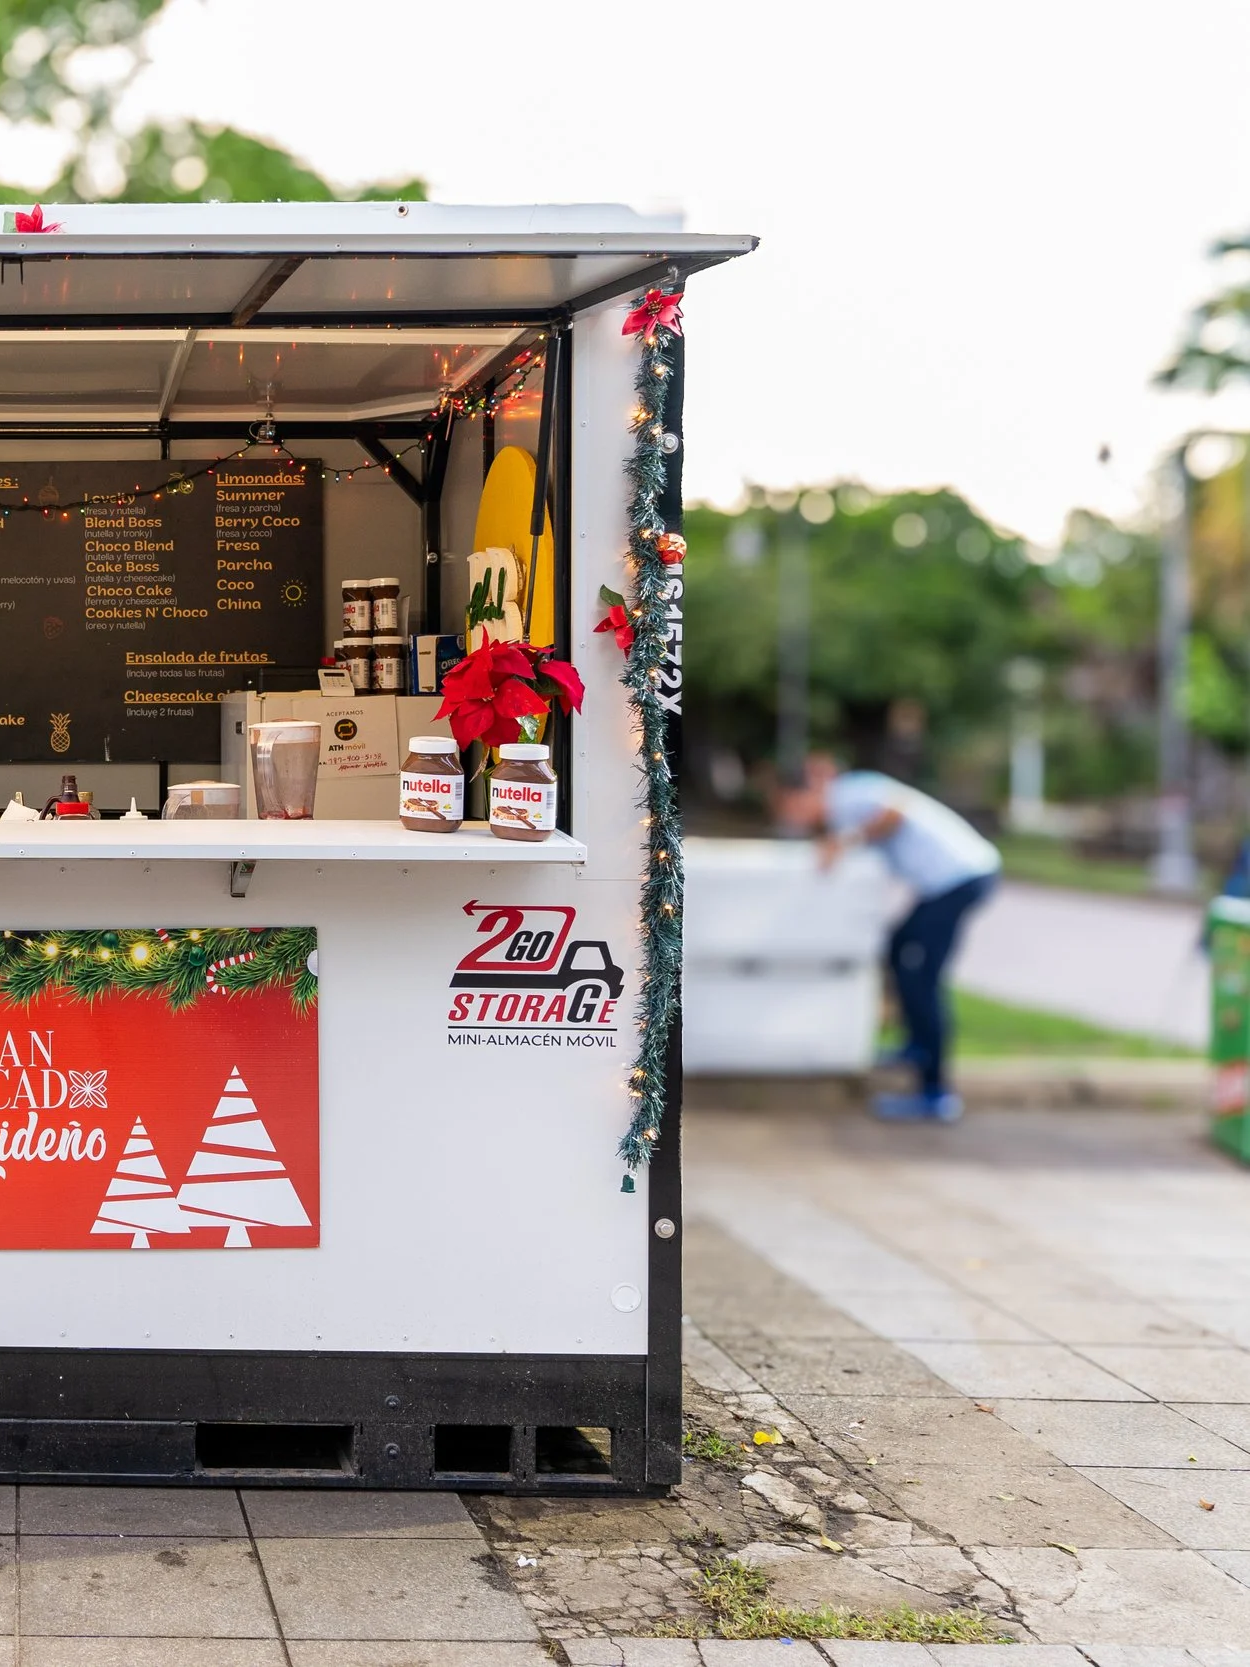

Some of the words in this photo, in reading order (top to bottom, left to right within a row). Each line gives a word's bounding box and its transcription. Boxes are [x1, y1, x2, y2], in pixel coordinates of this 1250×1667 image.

[216, 473, 305, 486] Limonadas:
[216, 490, 285, 500] Summer
[85, 507, 107, 516] (fresa
[117, 507, 146, 516] nutella)
[217, 503, 240, 513] (fresa
[249, 503, 281, 513] parcha)
[84, 517, 124, 528] Blend
[129, 517, 162, 528] Boss
[215, 516, 258, 528] Berry
[262, 516, 300, 527] Coco
[85, 529, 114, 539] (nutella
[123, 529, 152, 539] tronky)
[217, 529, 240, 538] (fresa
[249, 529, 272, 538] coco)
[85, 540, 130, 551] Choco
[135, 540, 174, 551] Blend
[216, 540, 260, 550] Fresa
[85, 553, 114, 562] (nutella
[124, 553, 155, 562] ferrero)
[85, 561, 122, 572] Cake
[126, 561, 160, 572] Boss
[216, 559, 272, 570] Parcha
[1, 575, 44, 586] melocotón
[54, 575, 76, 586] uvas)
[85, 574, 114, 583] (nutella
[124, 574, 175, 583] cheesecake)
[216, 579, 254, 590] Coco
[86, 585, 132, 596] Choco
[136, 585, 172, 596] Cake
[85, 597, 116, 606] (ferrero
[126, 597, 178, 606] cheesecake)
[216, 599, 261, 610] China
[85, 607, 141, 618] Cookies
[146, 607, 158, 618] N'
[163, 607, 208, 618] Choco
[86, 621, 107, 631] (oreo
[117, 621, 146, 631] nutella)
[125, 651, 194, 664] Ensalada
[198, 651, 215, 664] de
[220, 651, 270, 664] frutas
[160, 668, 182, 679] todas
[185, 668, 196, 679] las
[199, 668, 225, 679] frutas)
[124, 690, 214, 703] Cheesecake
[168, 707, 194, 718] frutas)
[328, 744, 344, 752] ATH
[345, 743, 366, 751] móvil
[402, 779, 451, 794] nutella
[492, 786, 543, 802] nutella
[448, 983, 618, 1023] STORAGE
[447, 1032, 562, 1047] MINI-ALMACÉN
[566, 1033, 617, 1048] MÓVIL
